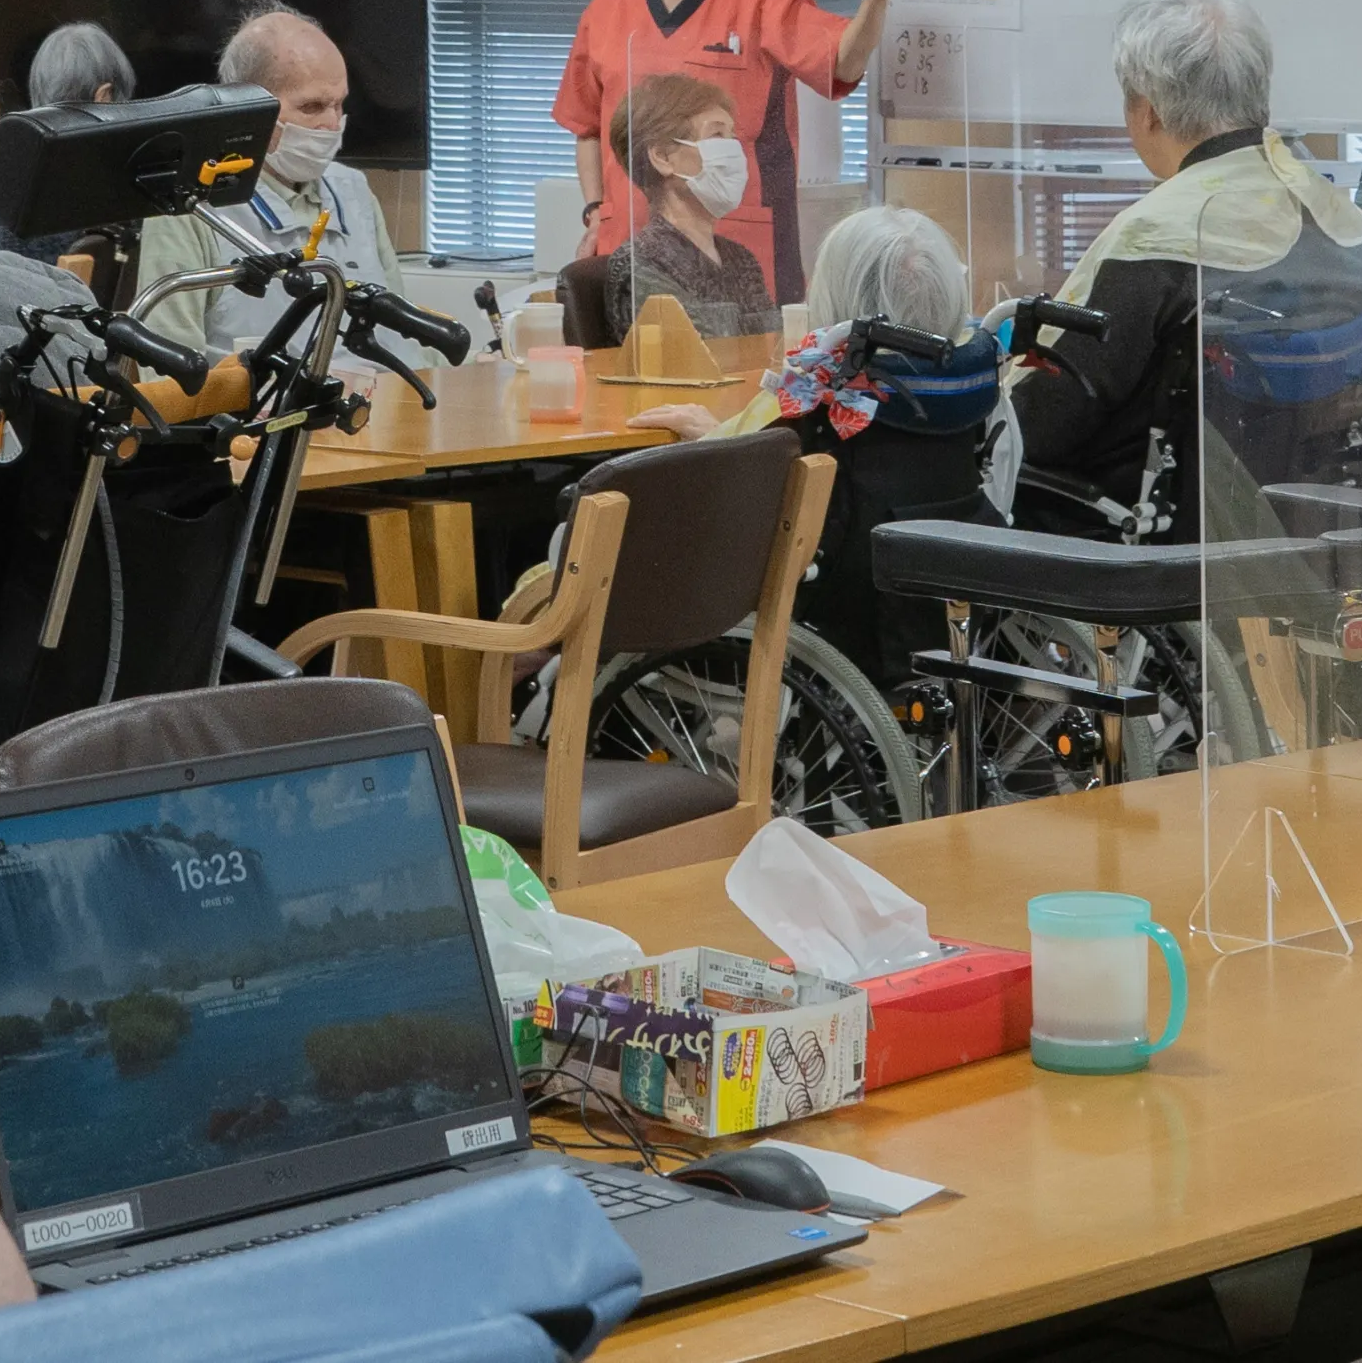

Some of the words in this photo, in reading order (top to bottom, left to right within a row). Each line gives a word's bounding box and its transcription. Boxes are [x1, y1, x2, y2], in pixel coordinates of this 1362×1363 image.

[896, 30, 911, 45] A
[894, 72, 907, 89] C
[172, 851, 247, 892] 16:23
